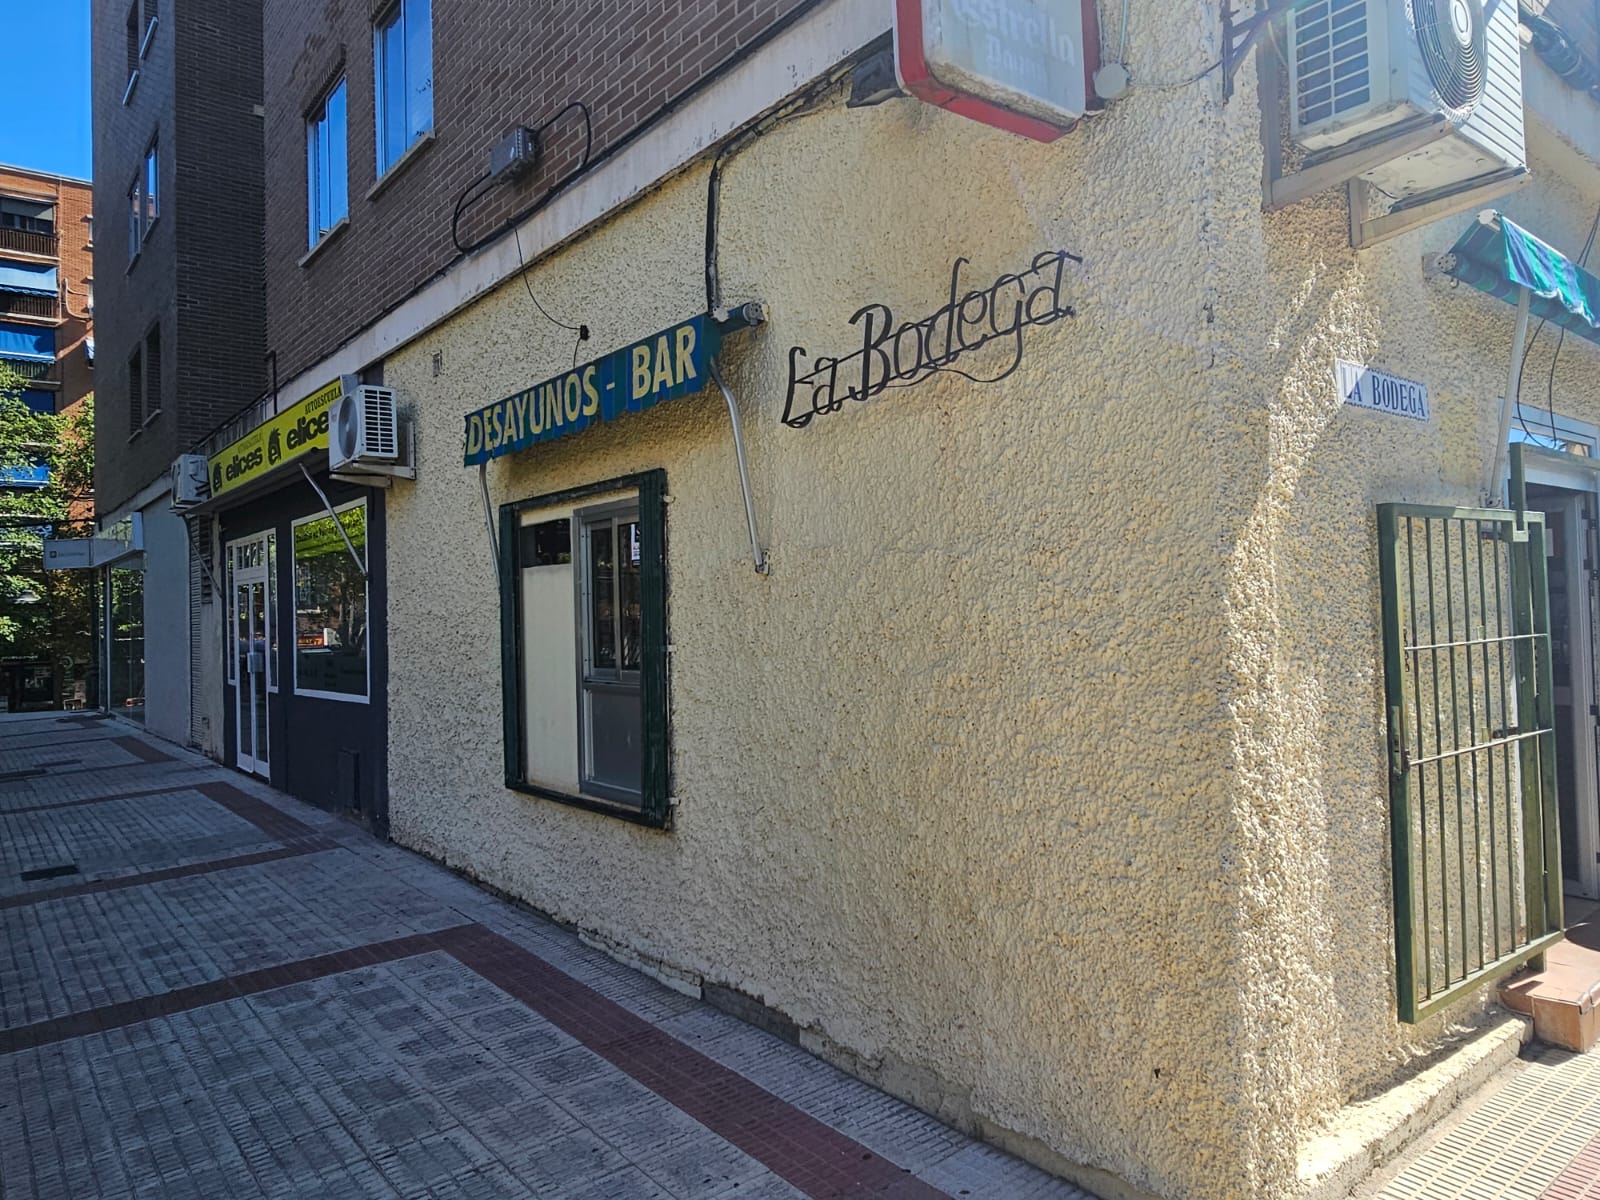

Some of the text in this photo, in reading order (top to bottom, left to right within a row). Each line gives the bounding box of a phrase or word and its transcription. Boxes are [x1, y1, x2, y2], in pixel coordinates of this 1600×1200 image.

[781, 251, 1083, 428] La Bodega
[467, 365, 599, 456] DESAYUNOS
[632, 325, 697, 400] BAR
[1343, 366, 1425, 417] LA BODEGA
[287, 411, 329, 450] elice
[225, 447, 263, 481] elices
